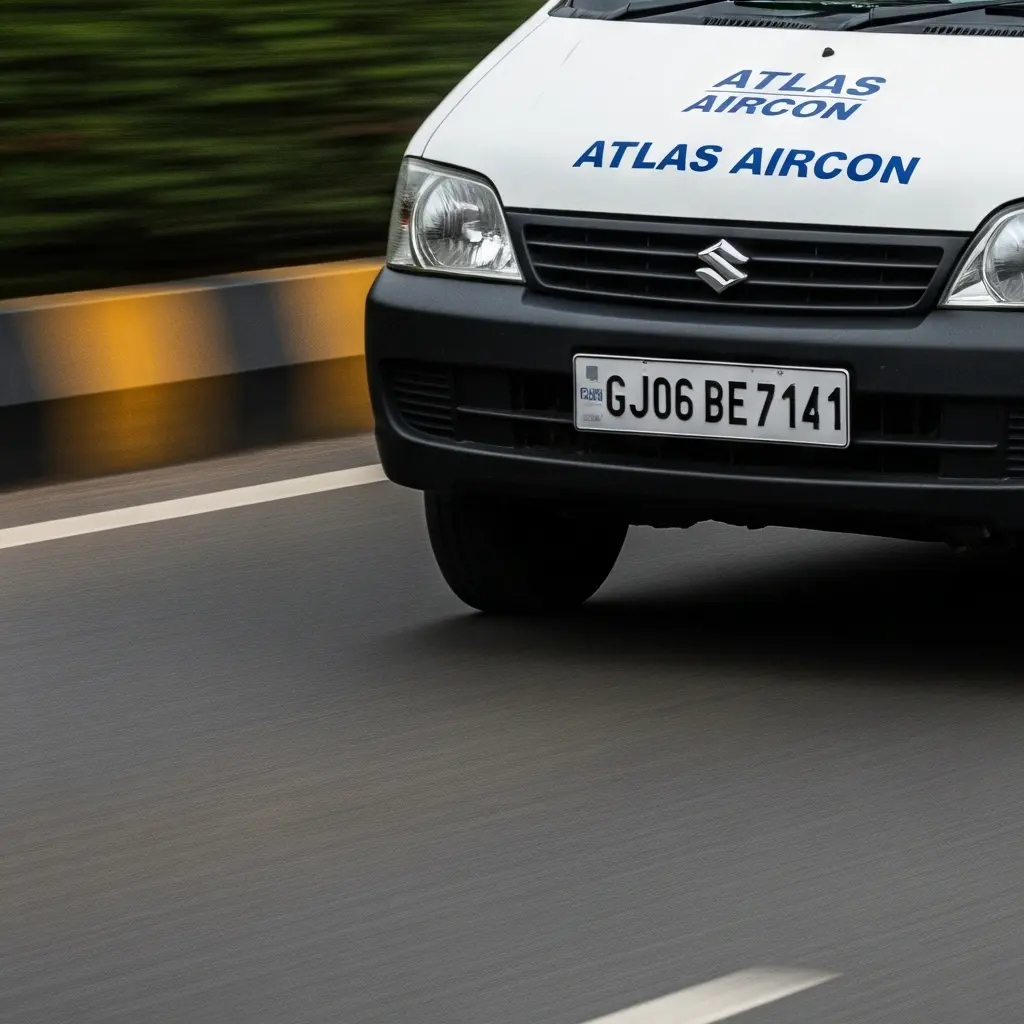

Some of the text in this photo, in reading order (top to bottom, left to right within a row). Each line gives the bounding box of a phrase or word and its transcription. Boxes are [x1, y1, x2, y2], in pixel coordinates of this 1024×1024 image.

[712, 69, 887, 96] ATLAS
[680, 95, 863, 121] AIRCON
[572, 140, 921, 185] ATLAS AIRCON
